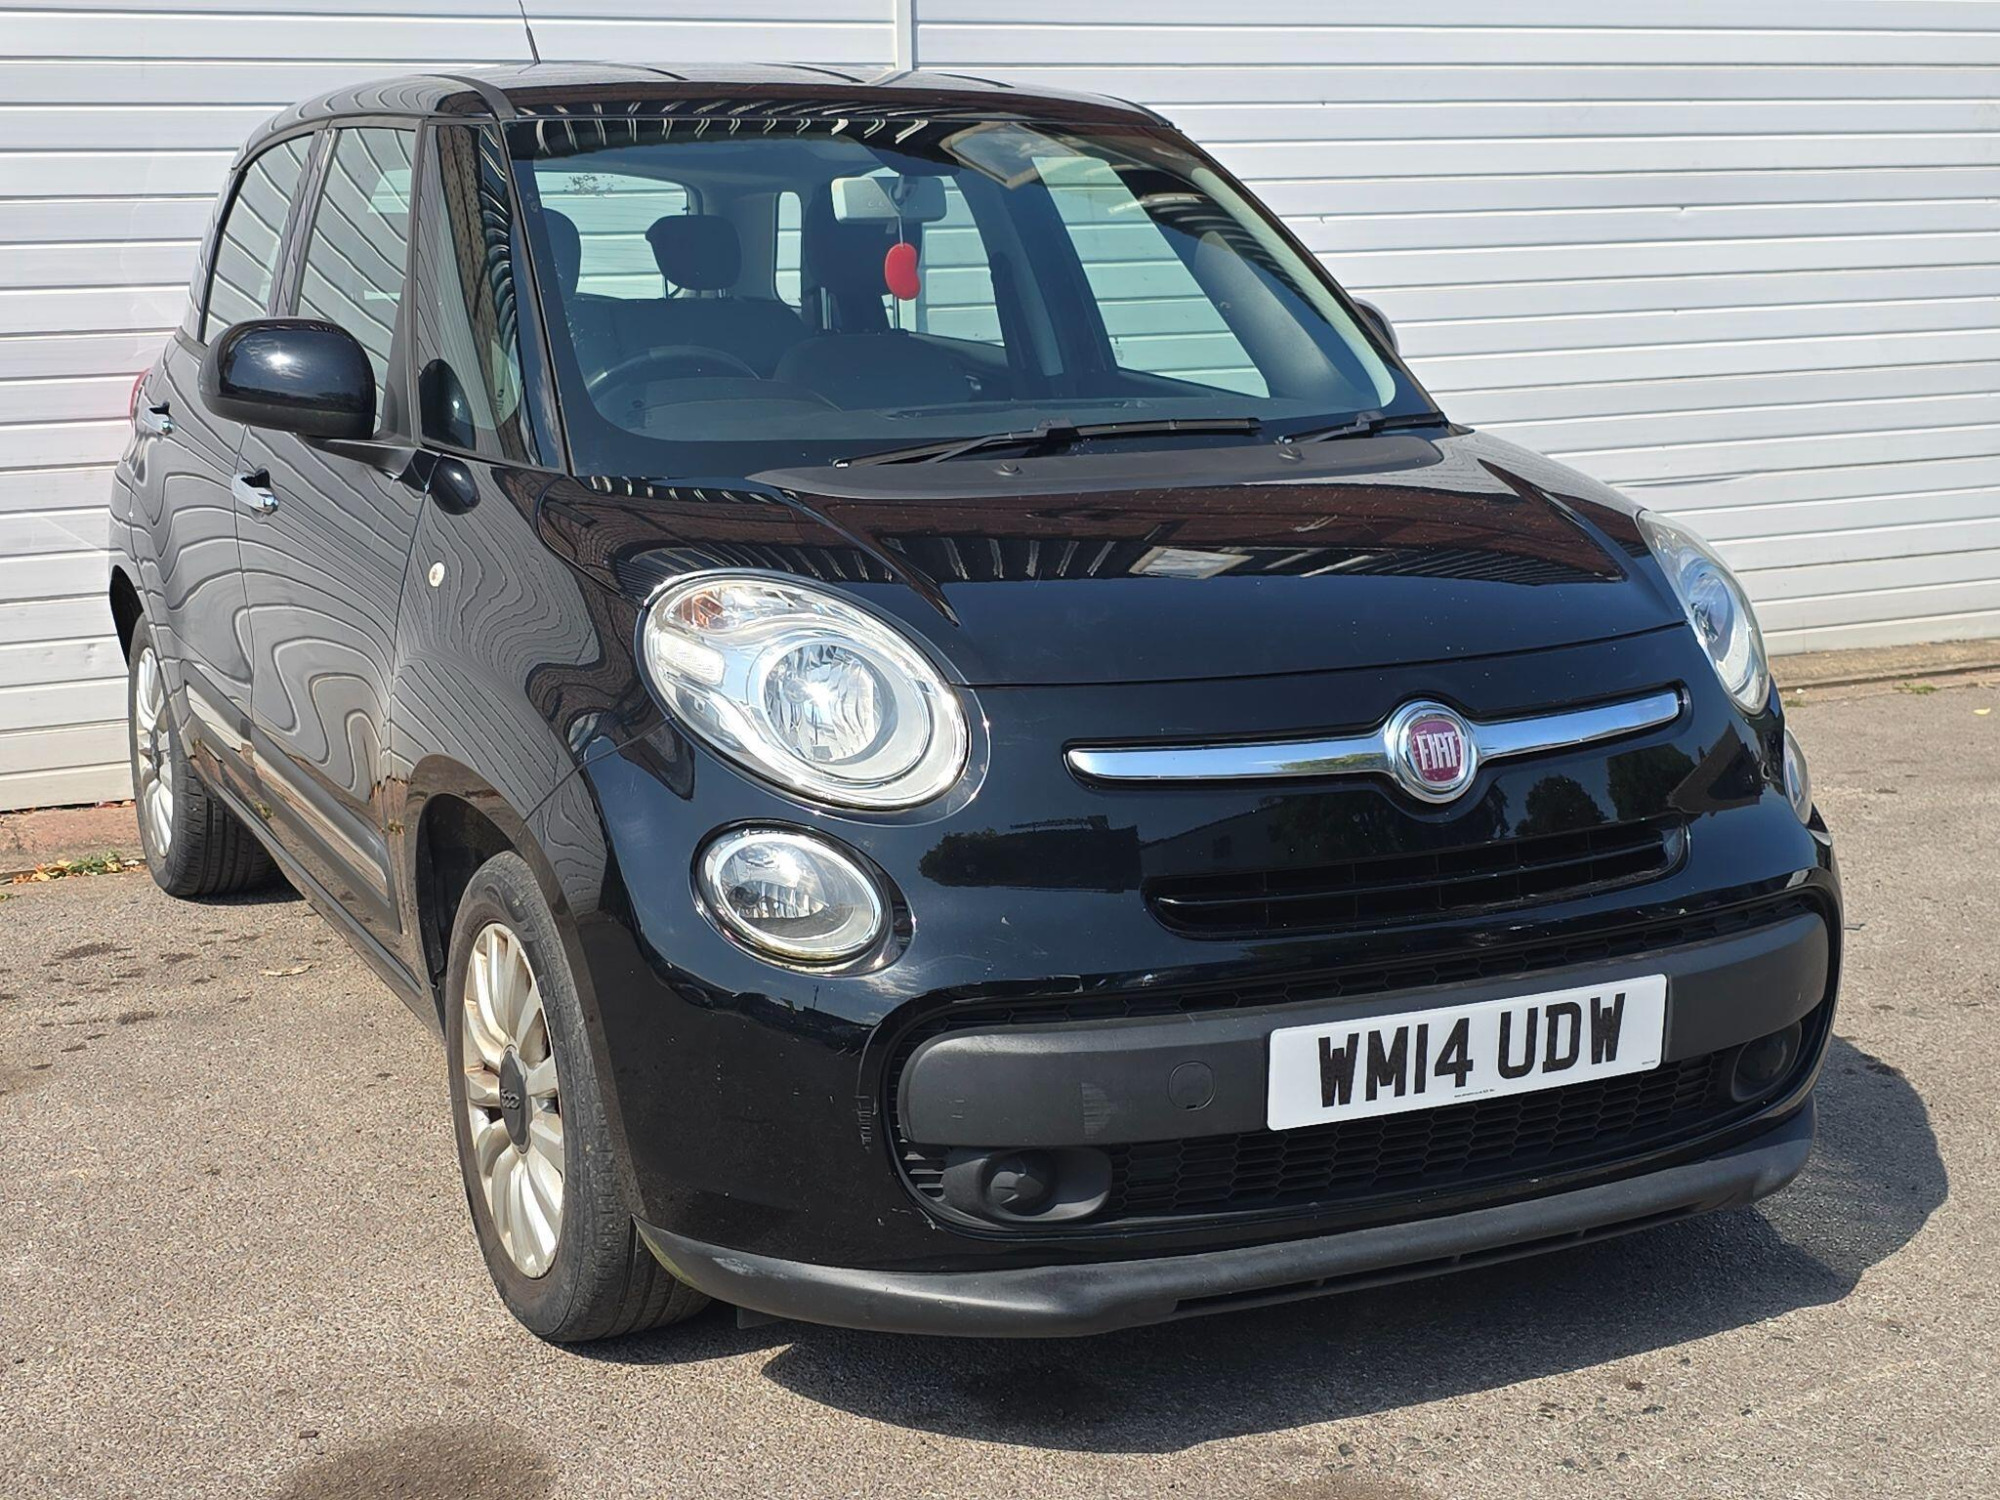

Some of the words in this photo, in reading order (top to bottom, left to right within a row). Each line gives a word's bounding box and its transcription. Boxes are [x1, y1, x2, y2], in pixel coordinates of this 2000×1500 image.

[1416, 731, 1457, 771] FIAT
[1318, 1017, 1474, 1108] WM14
[1498, 993, 1626, 1080] UDW
